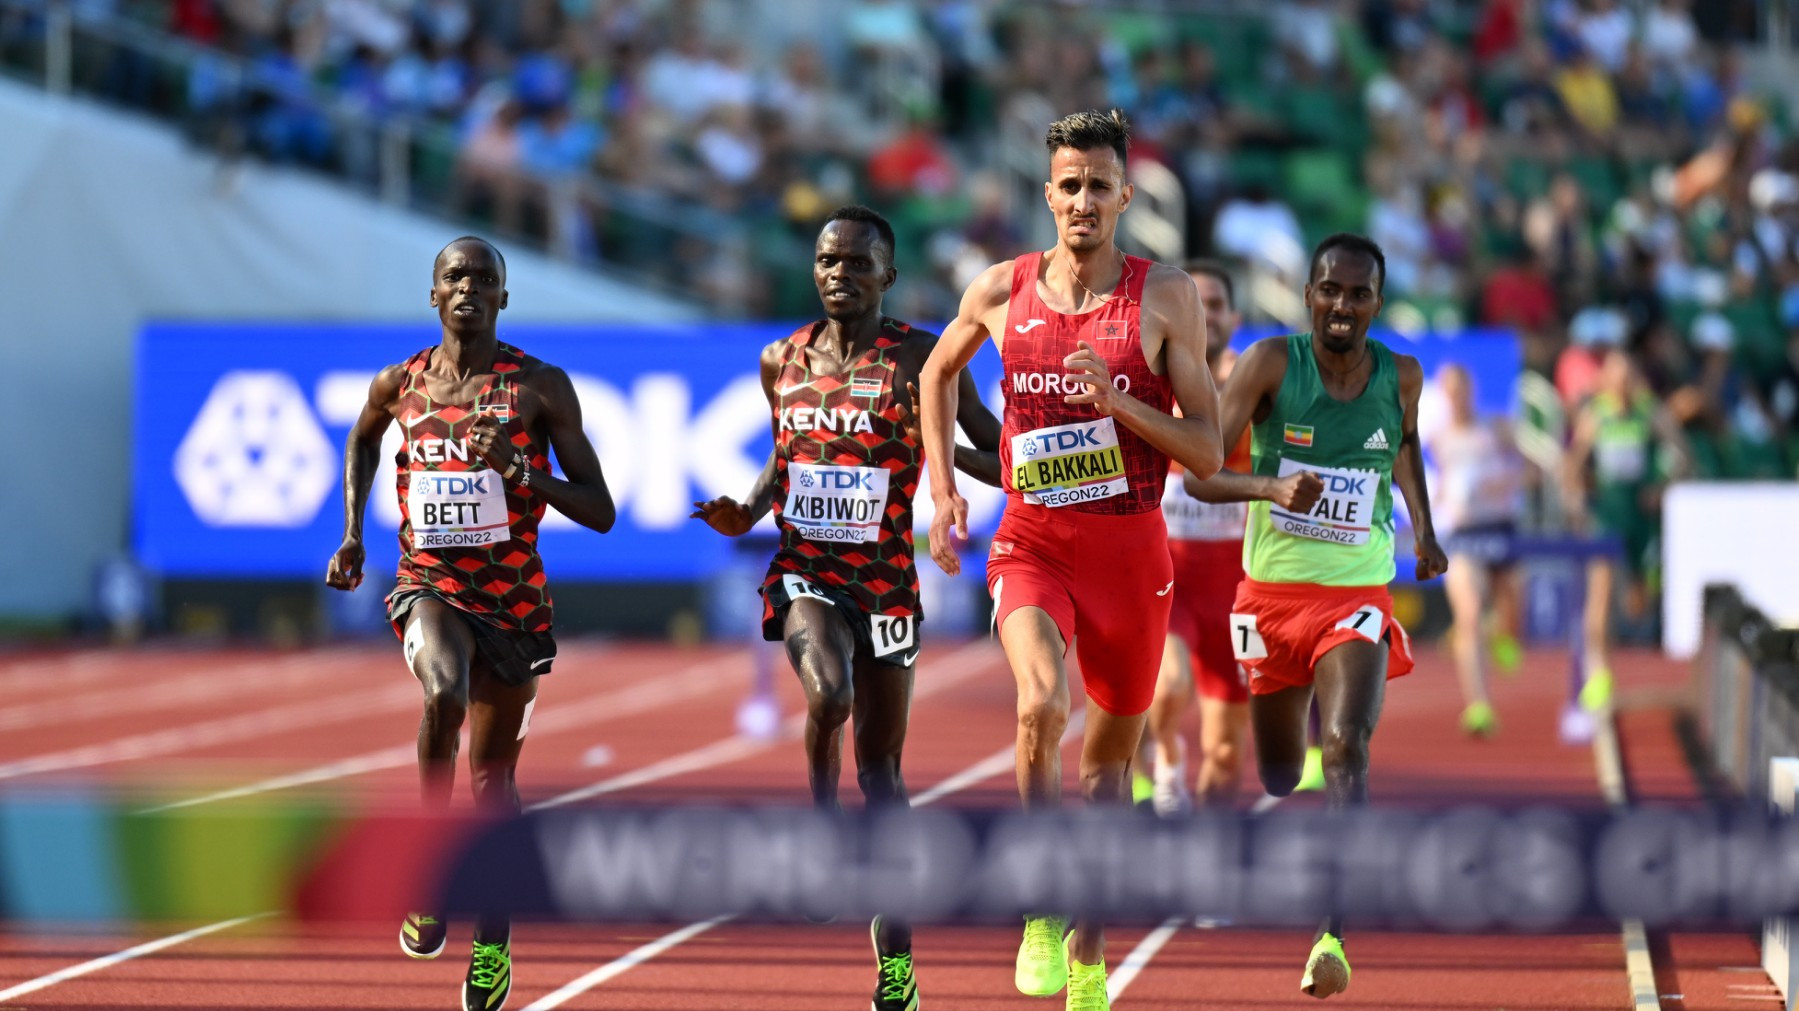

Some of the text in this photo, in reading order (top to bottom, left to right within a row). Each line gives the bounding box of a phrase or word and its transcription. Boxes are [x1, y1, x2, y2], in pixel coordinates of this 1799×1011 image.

[779, 407, 874, 433] KENYA
[408, 438, 483, 462] KEN
[1036, 427, 1101, 453] TDK
[1363, 441, 1389, 450] adidas
[815, 470, 873, 491] TDK
[1017, 449, 1118, 490] EL BAKKALI
[431, 477, 488, 495] TDK
[424, 503, 481, 525] BETT
[792, 495, 880, 521] KIBIWOT
[1304, 498, 1358, 522] ALE
[1284, 521, 1356, 543] OREGON22
[878, 616, 908, 648] 10
